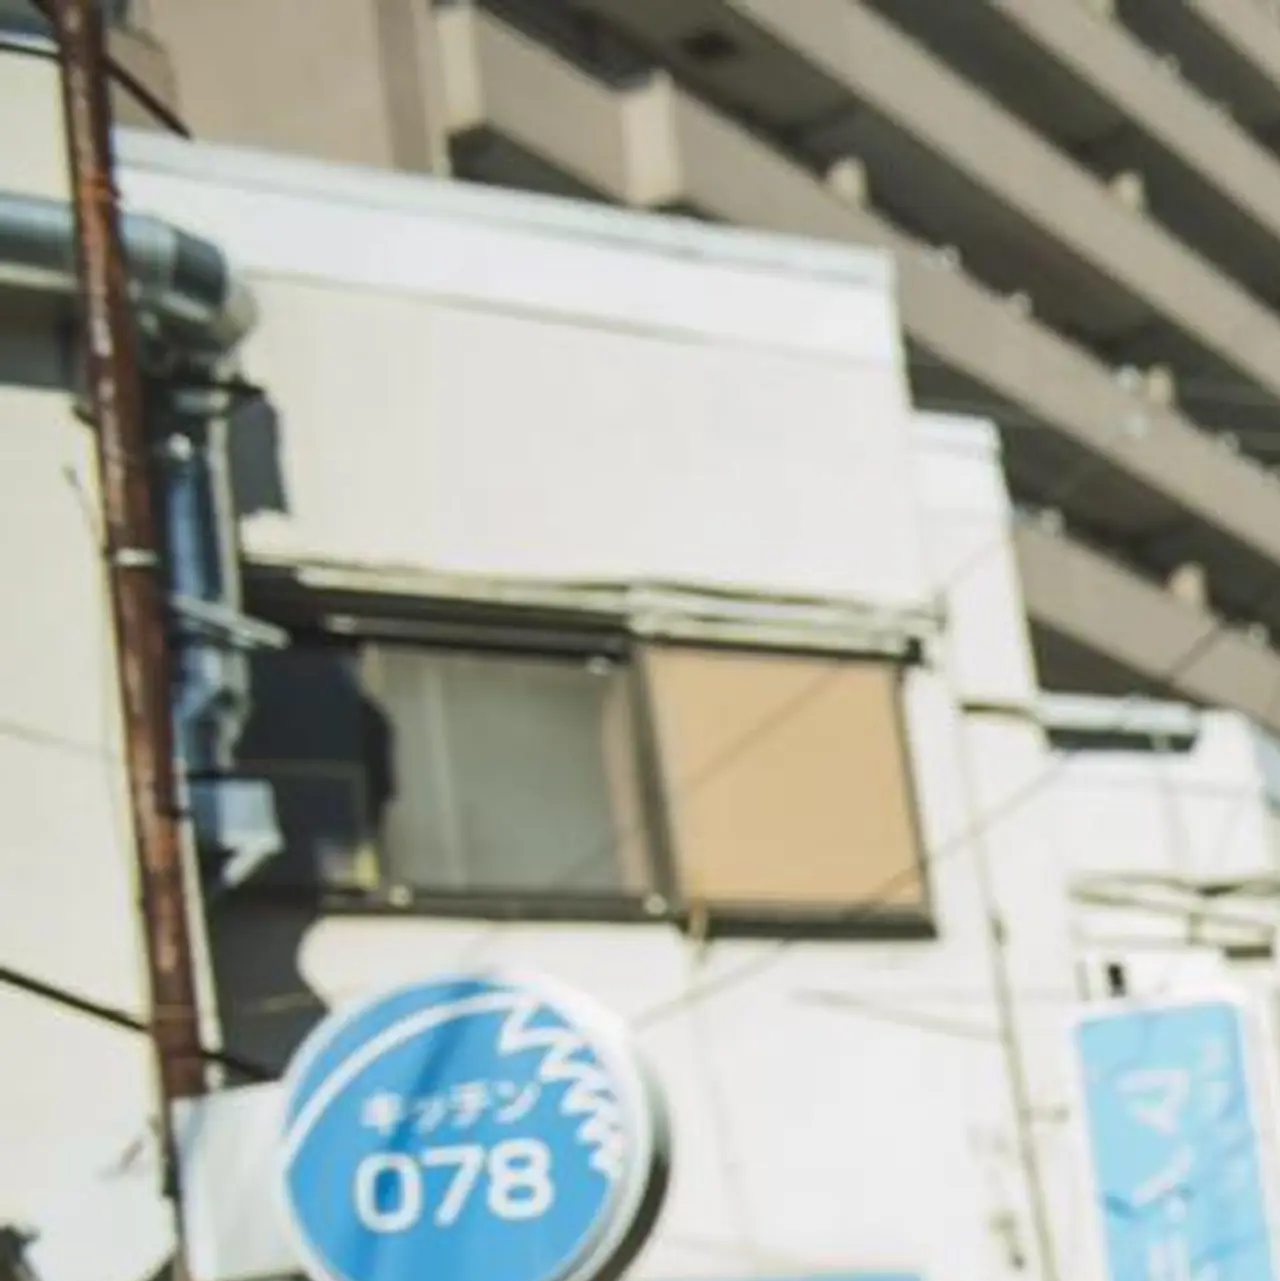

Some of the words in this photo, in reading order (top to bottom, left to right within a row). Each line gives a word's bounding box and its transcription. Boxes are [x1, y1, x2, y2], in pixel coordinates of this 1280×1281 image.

[360, 1080, 541, 1136] キッチン
[356, 1138, 556, 1234] 078
